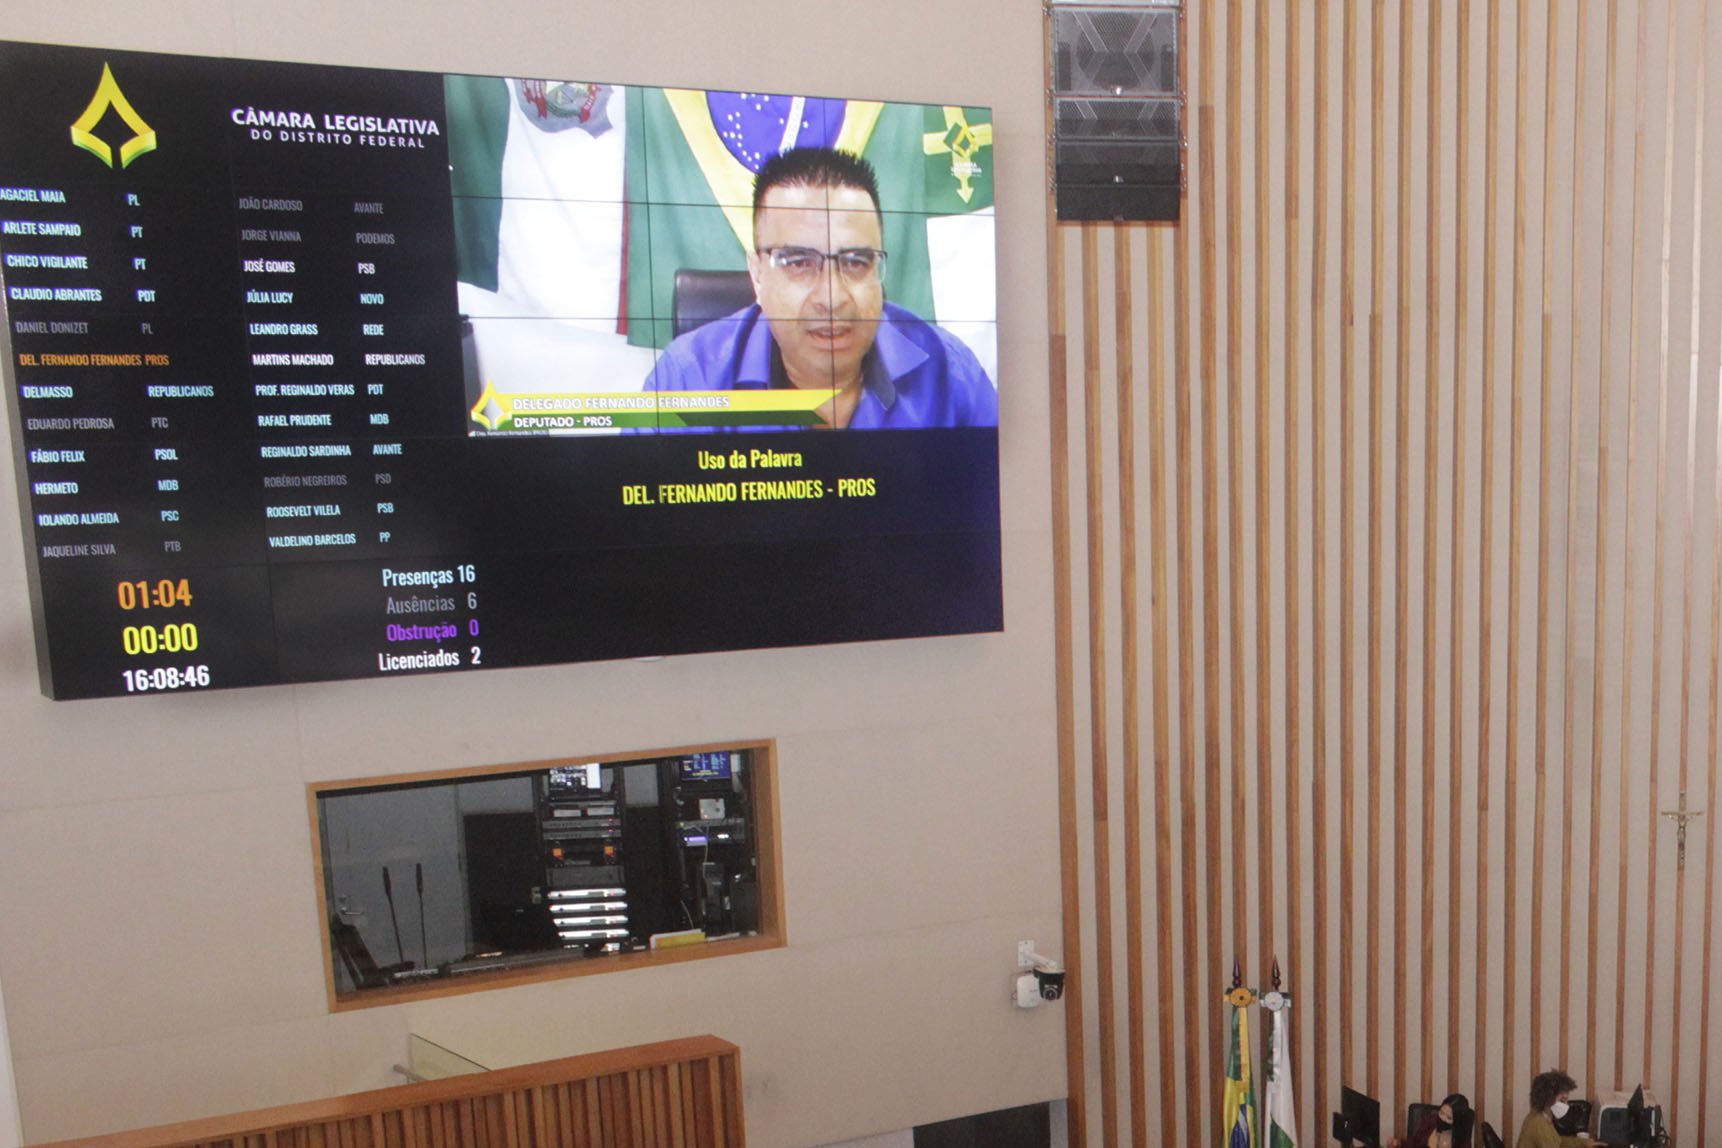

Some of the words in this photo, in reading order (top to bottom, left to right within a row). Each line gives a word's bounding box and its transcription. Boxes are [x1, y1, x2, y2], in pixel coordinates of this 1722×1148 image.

[232, 106, 315, 129] CÂMARA
[325, 113, 440, 135] LEGISLATIVA
[251, 129, 271, 141] DO
[280, 130, 352, 145] DISTRITO
[360, 134, 425, 148] FEDERAL
[0, 187, 38, 203] AGACIEL
[40, 190, 65, 203] MAIA
[127, 193, 140, 206] PL
[239, 196, 260, 211] JOÃO
[262, 198, 303, 212] CARDOSO
[354, 203, 384, 215] AVANTE
[3, 222, 36, 235] ARLETE
[38, 223, 81, 237] SAMPAIO
[131, 226, 143, 239] PT
[242, 229, 267, 242] JORGE
[269, 230, 302, 242] VIANNA
[356, 233, 395, 245] PODEMOS
[7, 254, 39, 268] CHICO
[40, 255, 88, 270] VIGILANTE
[134, 258, 146, 270] PT
[244, 259, 263, 272] JOSÉ
[266, 261, 295, 274] GOMES
[358, 262, 375, 275] PSB
[10, 287, 52, 301] CLAUDIO
[54, 288, 102, 302] ABRANTES
[138, 290, 156, 302] PDT
[246, 289, 268, 304] JÚLIA
[270, 291, 293, 304] LUCY
[360, 293, 384, 304] NOVO
[16, 321, 48, 334] DANIEL
[50, 321, 88, 334] DONIZET
[142, 323, 153, 335] PL
[250, 323, 288, 335] LEANDRO
[290, 323, 318, 336] GRASS
[363, 324, 384, 335] REDE
[20, 354, 39, 366] DEL.
[41, 354, 89, 367] FERNANDO
[91, 354, 142, 367] FERNANDES
[145, 354, 169, 366] PROS
[253, 353, 290, 366] MARTINS
[292, 354, 334, 366] MACHADO
[365, 353, 425, 365] REPUBLICANOS
[23, 385, 73, 398] DELMASSO
[147, 386, 214, 398] REPUBLICANOS
[256, 384, 280, 396] PROF.
[281, 384, 325, 396] REGINALDO
[327, 384, 355, 396] VERAS
[368, 383, 384, 395] PDT
[513, 398, 582, 410] DELEGADO
[586, 396, 656, 409] FERNANDO
[658, 396, 730, 409] FERNANDES
[28, 417, 71, 430] EDUARDO
[73, 417, 114, 430] PEDROSA
[152, 417, 168, 428] PTC
[258, 415, 289, 427] RAFAEL
[291, 414, 332, 426] PRUDENTE
[370, 414, 389, 425] MDB
[514, 417, 574, 428] DEPUTADO
[584, 416, 612, 426] PROS
[32, 448, 59, 463] FÁBIO
[61, 451, 85, 462] FELIX
[154, 448, 178, 461] PSOL
[261, 445, 307, 458] REGINALDO
[309, 444, 351, 457] SARDINHA
[373, 444, 402, 455] AVANTE
[698, 450, 725, 470] Uso
[730, 450, 746, 469] da
[751, 448, 802, 468] Palavra
[35, 482, 78, 495] HERMETO
[158, 479, 178, 491] MDB
[264, 473, 299, 487] ROBÉRIO
[301, 474, 347, 486] NEGREIROS
[375, 473, 391, 485] PSD
[622, 485, 654, 505] DEL.
[659, 482, 736, 504] FERNANDO
[742, 480, 823, 500] FERNANDES
[838, 478, 876, 498] PROS
[38, 513, 78, 526] IOLANDO
[80, 512, 119, 525] ALMEIDA
[161, 510, 179, 522] PSC
[267, 505, 311, 518] ROOSEVELT
[313, 504, 341, 516] VILELA
[377, 503, 394, 514] PSB
[269, 535, 313, 548] VALDELINO
[315, 533, 356, 546] BARCELOS
[379, 532, 390, 543] PP
[43, 545, 90, 558] JAQUELINE
[92, 544, 116, 556] SILVA
[165, 541, 181, 552] PTB
[382, 568, 453, 589] Presenças
[457, 565, 475, 583] 16
[118, 579, 192, 610] 01:04
[386, 596, 455, 615] Ausências
[468, 592, 477, 610] 6
[123, 624, 198, 655] 00:00
[387, 622, 457, 644] Obstrução
[470, 620, 479, 637] 0
[379, 650, 459, 671] Licenciados
[471, 647, 481, 665] 2
[123, 666, 210, 692] 16:08:46
